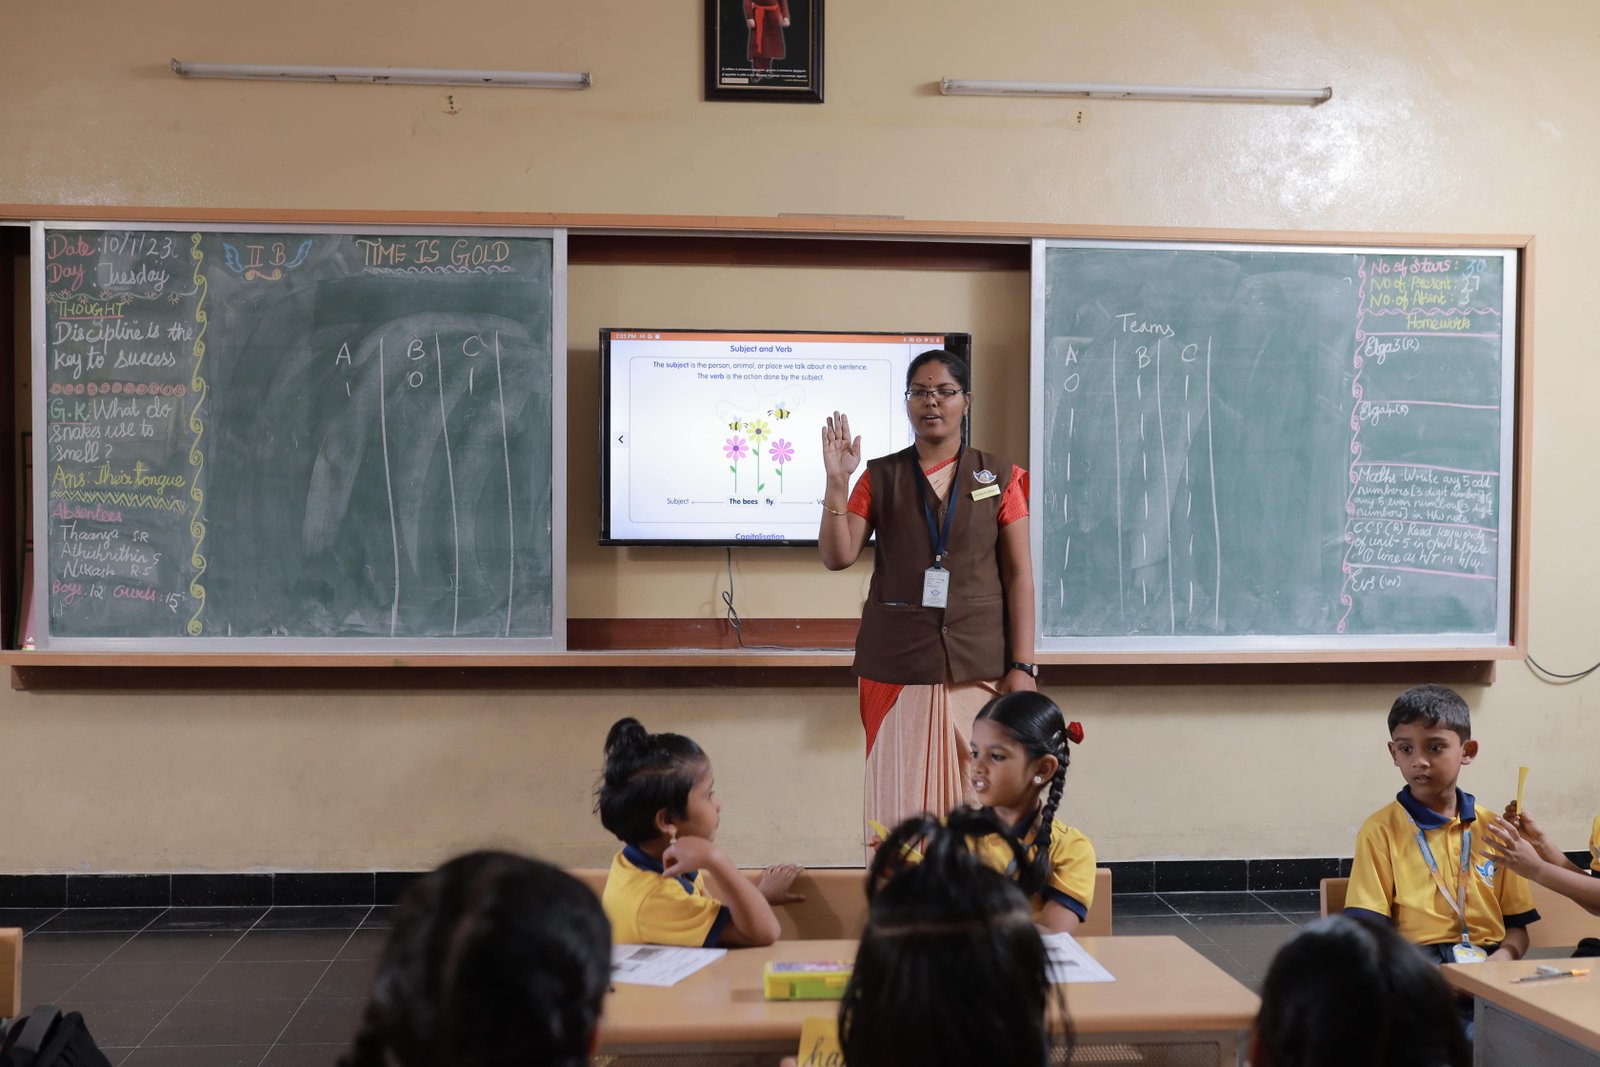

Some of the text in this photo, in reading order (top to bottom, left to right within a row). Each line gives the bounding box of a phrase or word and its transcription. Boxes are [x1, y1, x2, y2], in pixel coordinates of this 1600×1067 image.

[269, 242, 286, 266] B
[356, 239, 510, 266] TIME IS GOLD
[47, 264, 85, 291] Day
[98, 263, 169, 291] Tuesday
[59, 302, 124, 317] THOUGHT
[1115, 313, 1175, 337] Teams
[1407, 312, 1471, 330] Homework
[52, 320, 193, 355] Discipline is the
[86, 345, 104, 371] to
[114, 348, 176, 369] success
[336, 336, 481, 365] A B C
[730, 345, 757, 353] Subject
[759, 345, 773, 353] and
[1065, 344, 1197, 369] A B C
[666, 361, 689, 369] subject
[733, 362, 756, 370] animal,
[765, 363, 782, 371] place
[779, 374, 788, 382] by
[94, 397, 140, 420] What
[147, 396, 172, 419] do
[48, 419, 154, 443] snakes use to
[51, 441, 99, 463] smell
[93, 464, 133, 485] Their
[133, 461, 185, 494] tongue
[1443, 475, 1461, 490] any
[1463, 476, 1470, 487] 5
[1472, 474, 1492, 488] odd
[667, 498, 689, 506] Subject
[1358, 484, 1409, 497] numbers
[1425, 485, 1447, 501] digit
[51, 502, 123, 523] Absentees
[1354, 497, 1374, 509] any
[1378, 497, 1385, 506] 5
[1412, 511, 1423, 520] in
[1407, 523, 1432, 537] Read
[1402, 538, 1411, 548] 5
[1413, 538, 1423, 549] in
[153, 553, 162, 565] S
